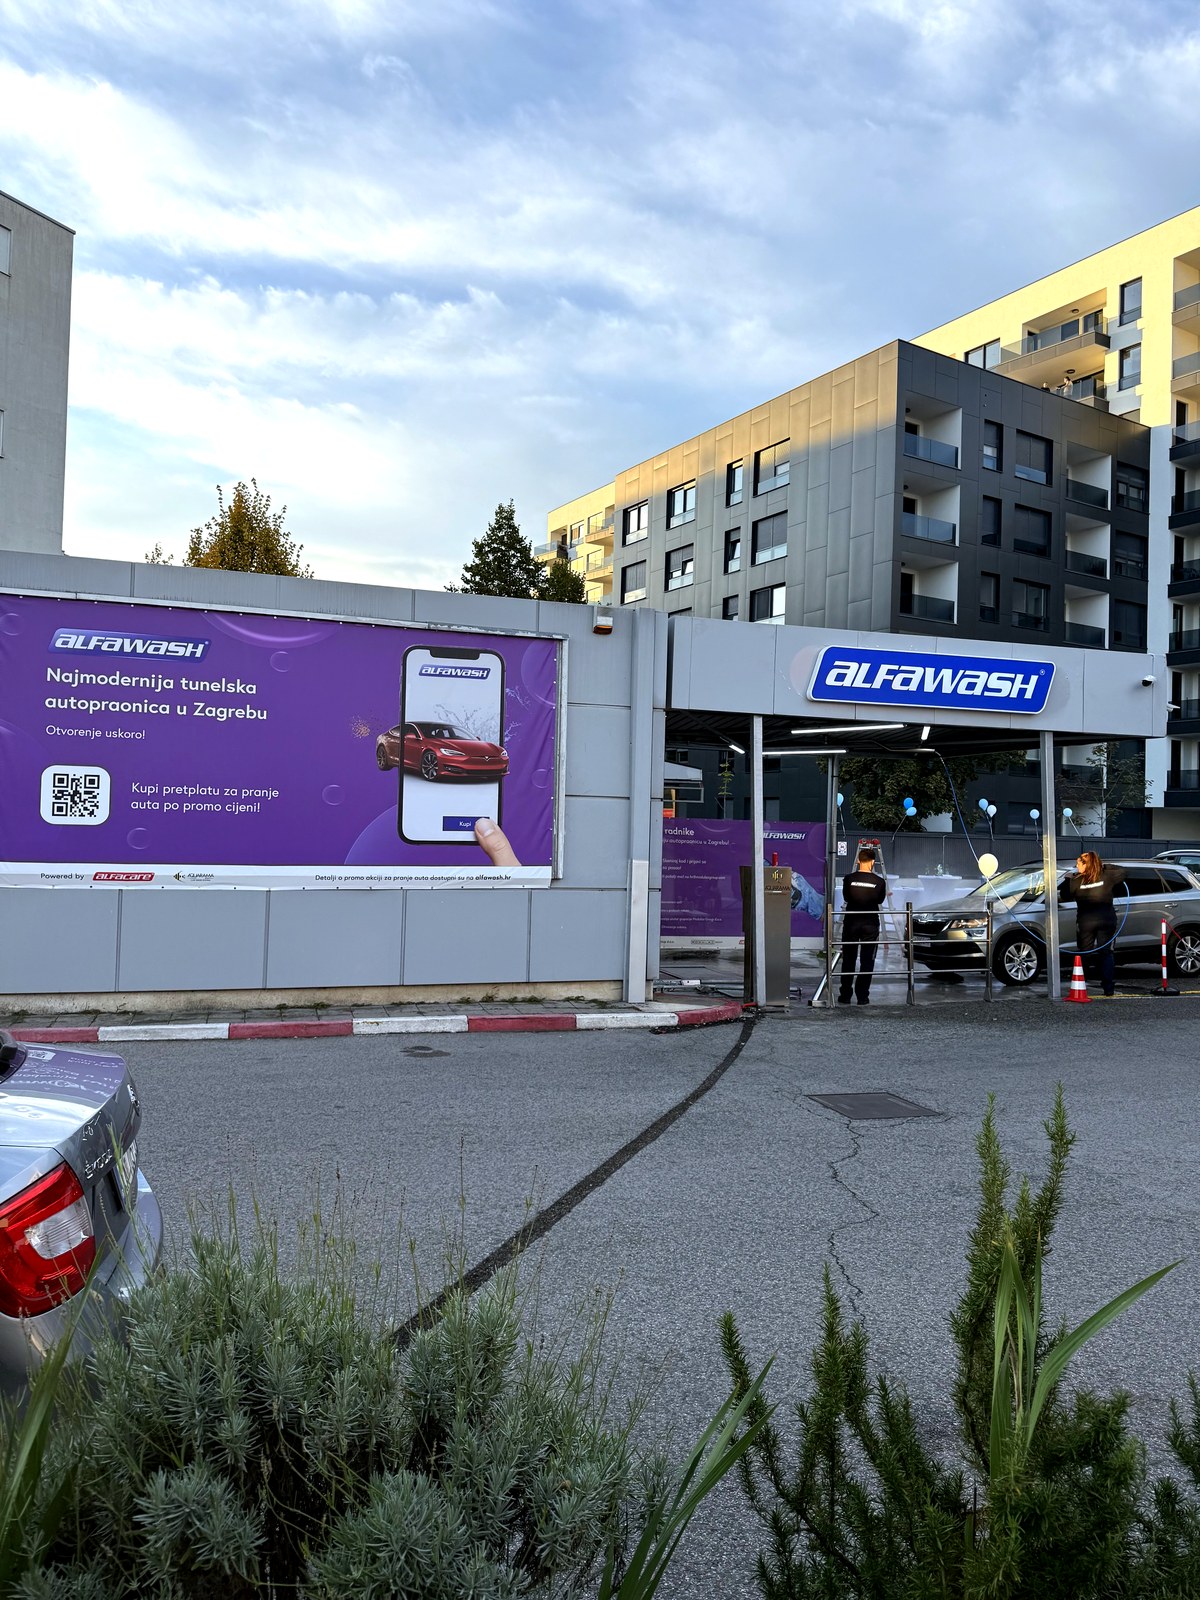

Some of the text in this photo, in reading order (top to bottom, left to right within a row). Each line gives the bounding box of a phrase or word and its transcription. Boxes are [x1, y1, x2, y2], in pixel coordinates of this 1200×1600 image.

[46, 668, 257, 695] Najmodernija tunelska
[45, 696, 267, 721] autopraonica u Zagrebu
[46, 725, 146, 739] Otvorenje uskoro!
[131, 782, 279, 799] Kupi pretplatu za pranje
[131, 801, 261, 814] auta po promo cijeni!
[459, 820, 472, 828] Kupi
[664, 827, 695, 836] radnike
[40, 872, 85, 881] Powered by
[315, 874, 337, 882] Detalji
[429, 874, 457, 882] dostupni
